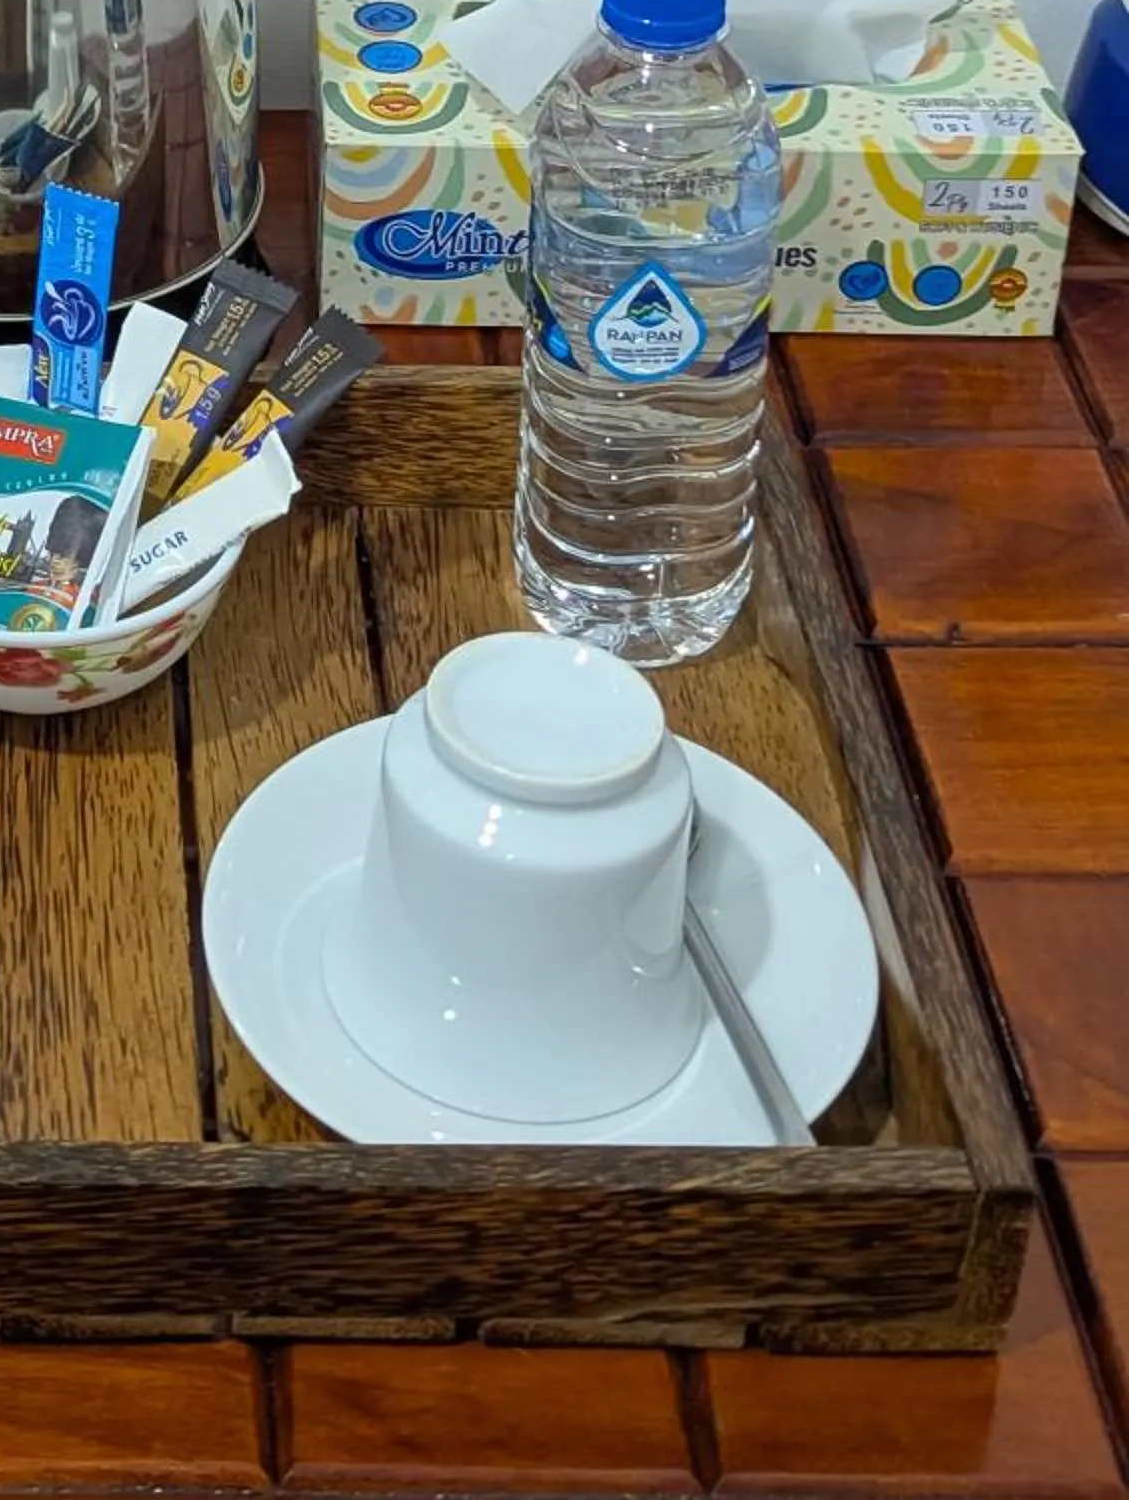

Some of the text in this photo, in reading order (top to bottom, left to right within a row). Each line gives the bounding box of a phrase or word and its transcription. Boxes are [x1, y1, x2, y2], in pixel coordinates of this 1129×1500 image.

[992, 185, 1028, 198] 150
[382, 210, 533, 260] Mint
[129, 530, 189, 573] SUGAR
